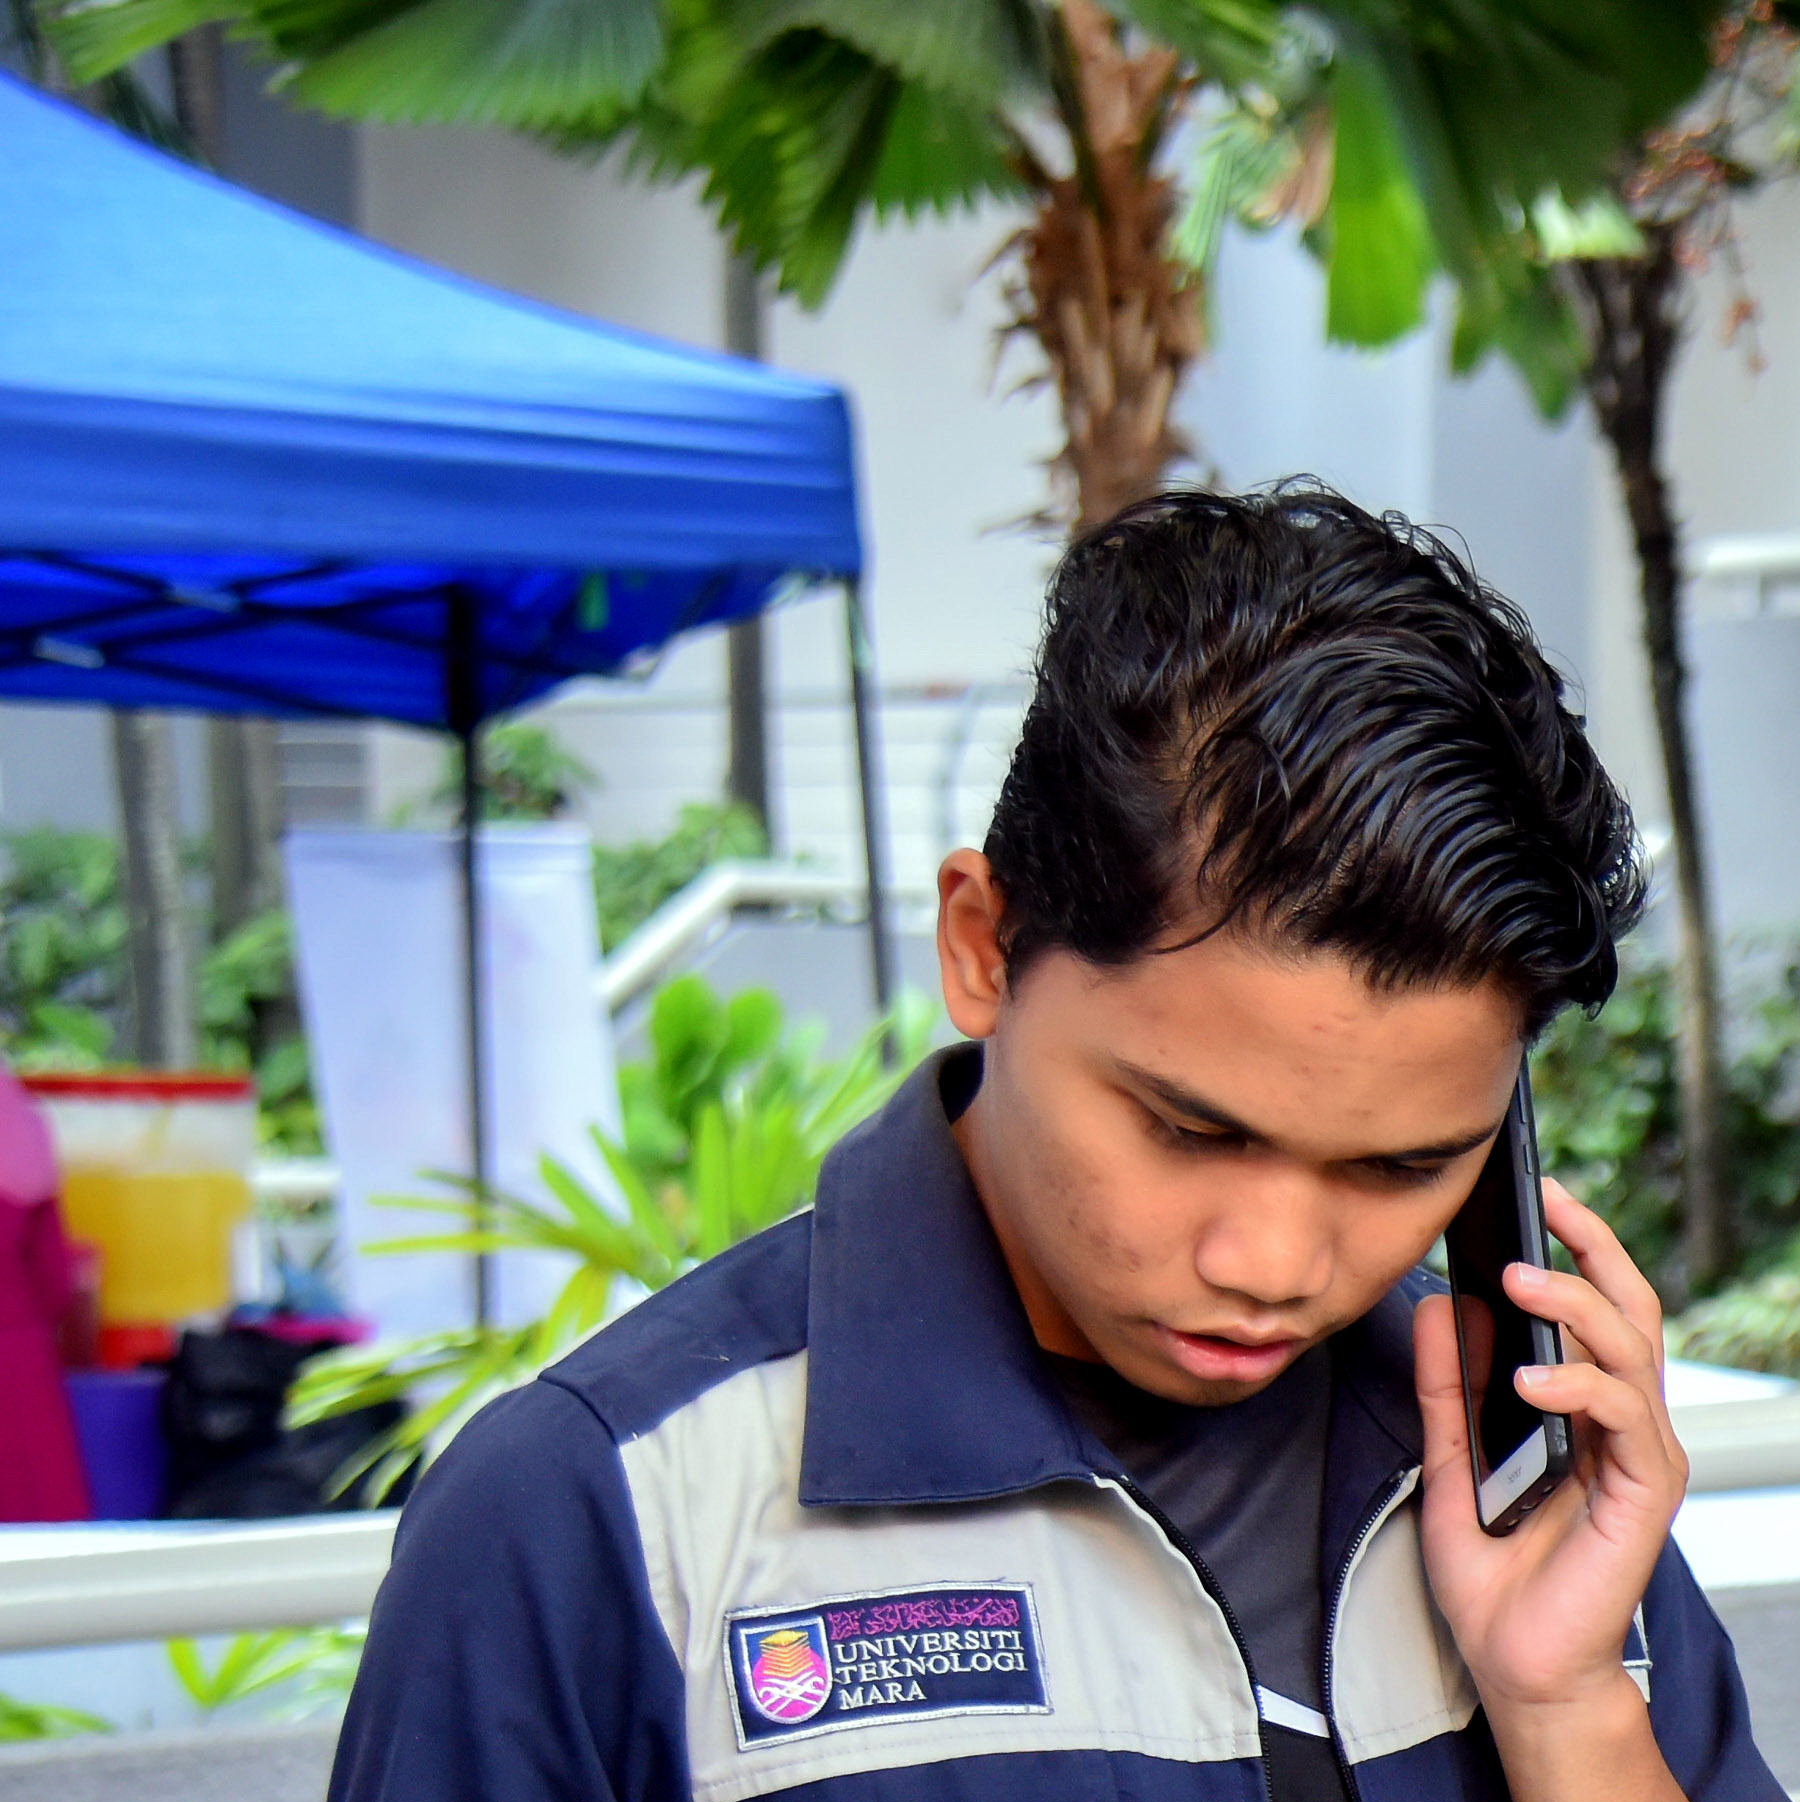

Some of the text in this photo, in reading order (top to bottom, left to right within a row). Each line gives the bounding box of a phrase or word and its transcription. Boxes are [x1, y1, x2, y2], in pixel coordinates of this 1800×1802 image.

[836, 1630, 1024, 1664] UNIVERSITI
[833, 1652, 1028, 1685] TEKNOLOGI
[839, 1680, 927, 1710] MARA
